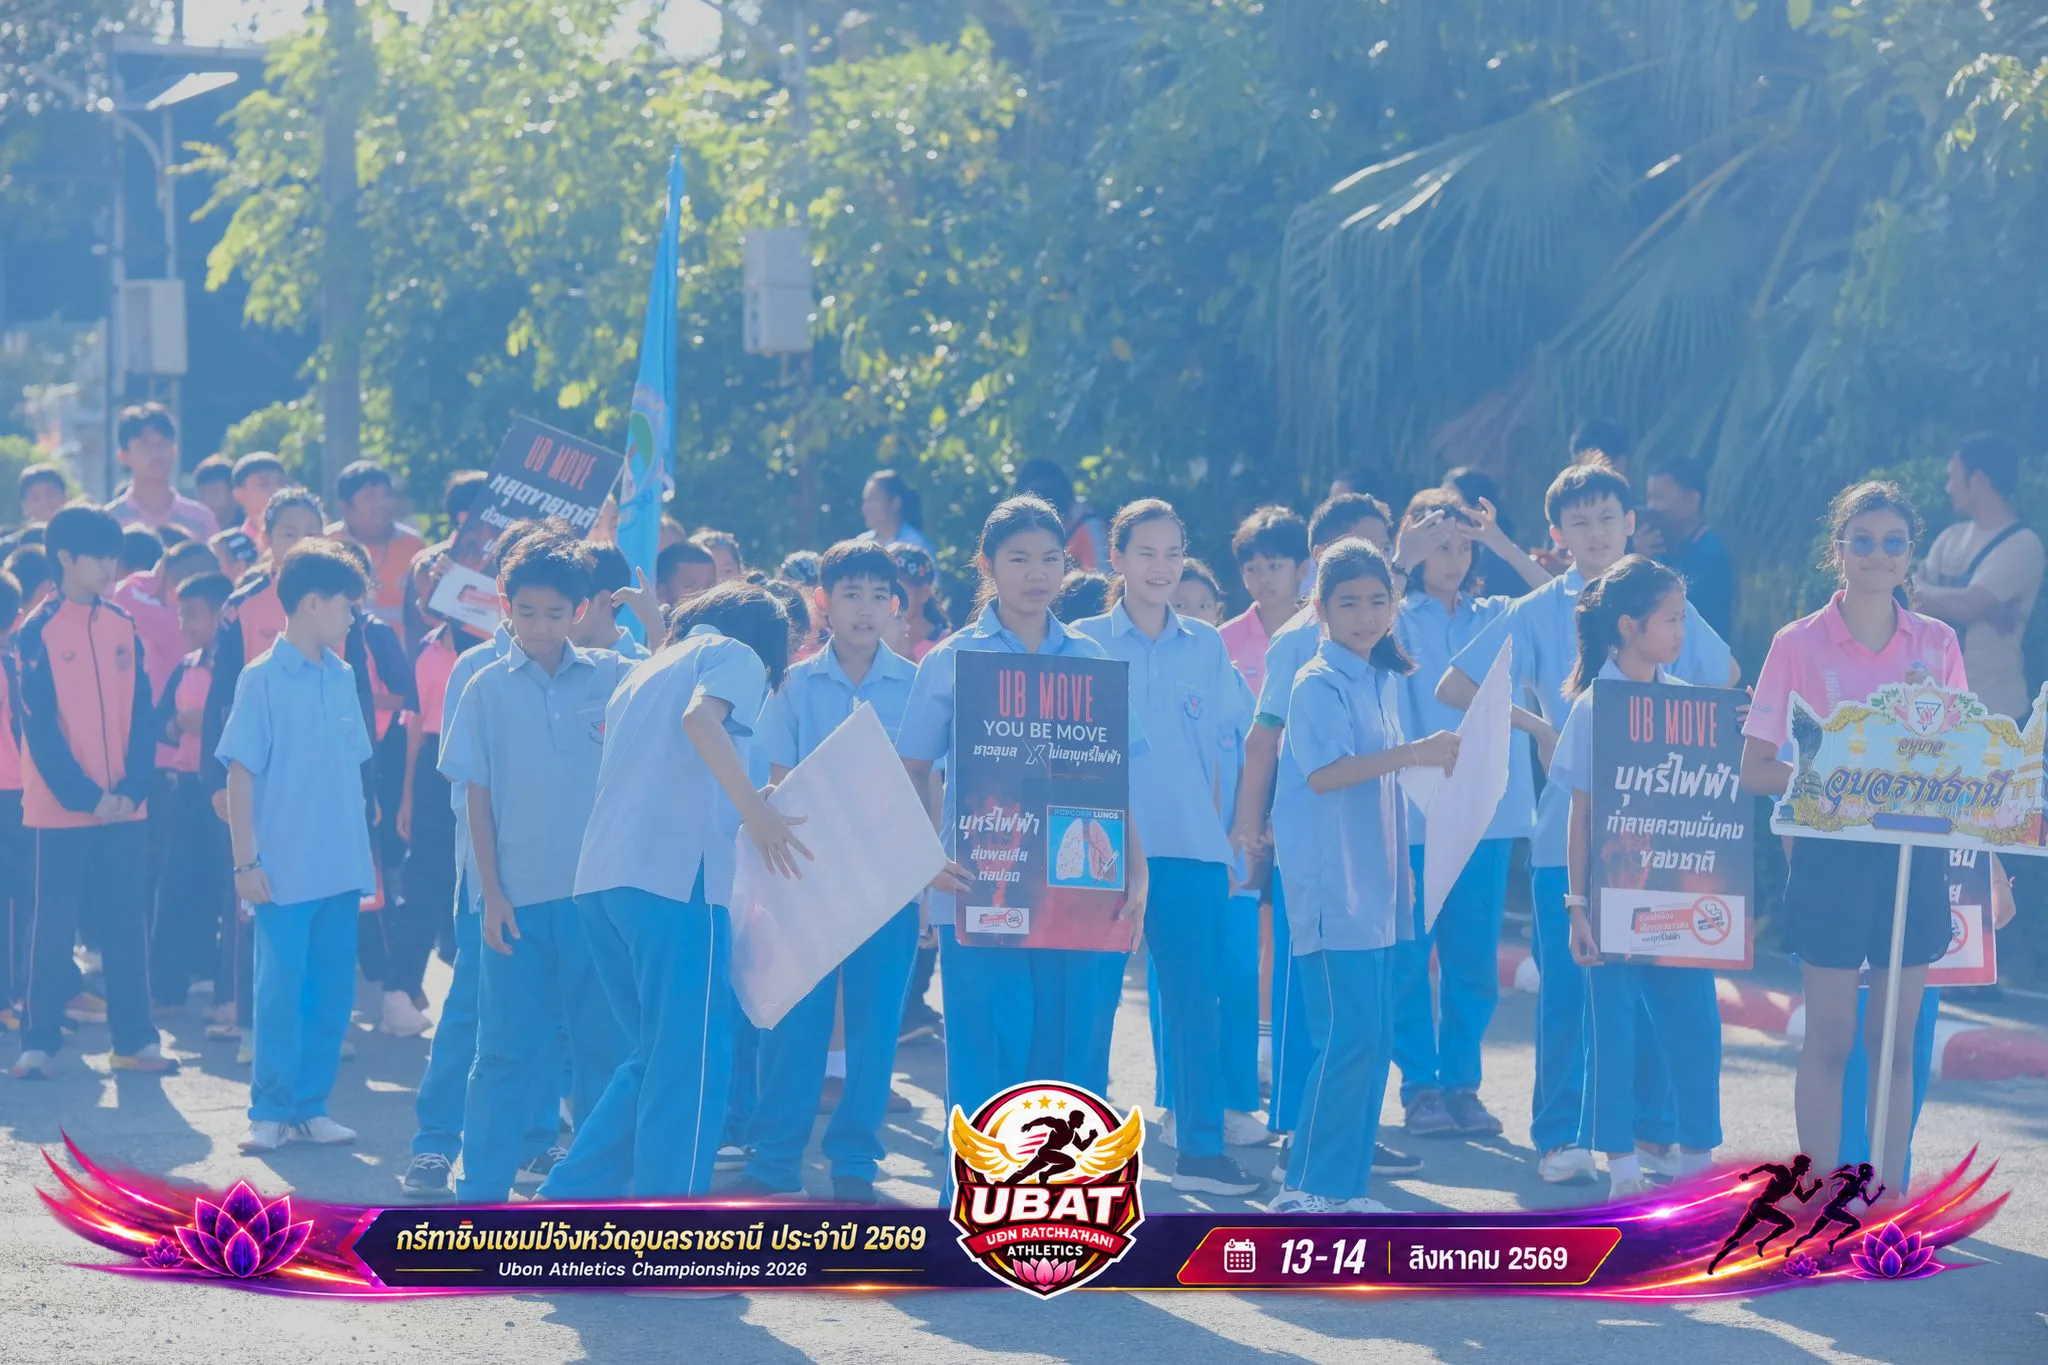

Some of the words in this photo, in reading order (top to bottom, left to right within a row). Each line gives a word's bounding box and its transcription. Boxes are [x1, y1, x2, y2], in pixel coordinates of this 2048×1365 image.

[524, 433, 554, 473] UB
[547, 444, 598, 491] MOVE
[999, 669, 1026, 718] UB
[1039, 671, 1093, 723] MOVE
[983, 720, 1024, 738] YOU
[1030, 722, 1052, 739] BE
[1057, 724, 1107, 743] MOVE
[1629, 695, 1654, 743] UB
[1665, 698, 1718, 748] MOVE
[973, 744, 1018, 763] ชาวอุบล
[1897, 736, 1945, 761] อนุบาล
[1614, 751, 1740, 808] บุหรี่ไฟฟ้า
[1824, 765, 2015, 815] อุบลราชธานี
[959, 806, 1040, 841] บุหรี่ไฟฟ้า
[1053, 808, 1091, 818] POPCORN
[1093, 811, 1119, 820] LUNGS
[1606, 809, 1744, 841] ทำลายความมั่นคง
[1639, 848, 1716, 877] ของชาติ
